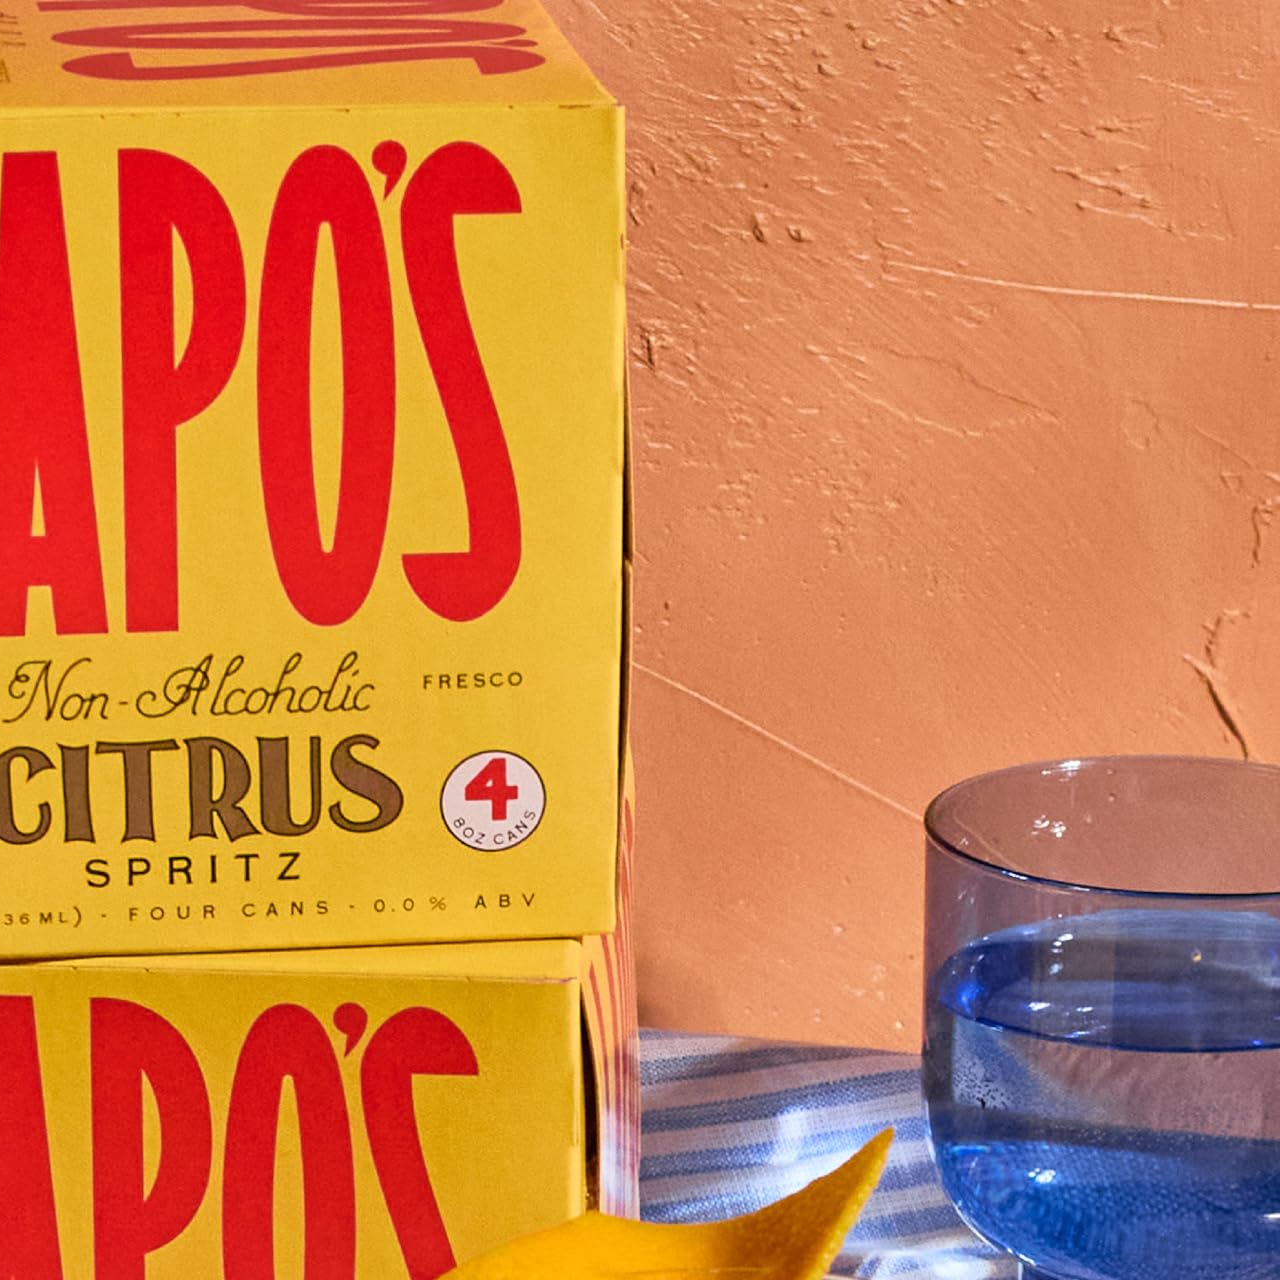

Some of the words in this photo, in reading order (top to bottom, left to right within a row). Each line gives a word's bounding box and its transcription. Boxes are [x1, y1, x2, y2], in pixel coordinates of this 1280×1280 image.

[2, 651, 375, 723] Non-Alcoholic
[422, 672, 523, 689] FRESCO
[465, 758, 518, 821] 4
[493, 810, 536, 845] CANS
[85, 853, 300, 888] SPRITZ
[129, 905, 215, 922] FOUR
[242, 901, 329, 918] CANS
[475, 893, 535, 909] ABV
